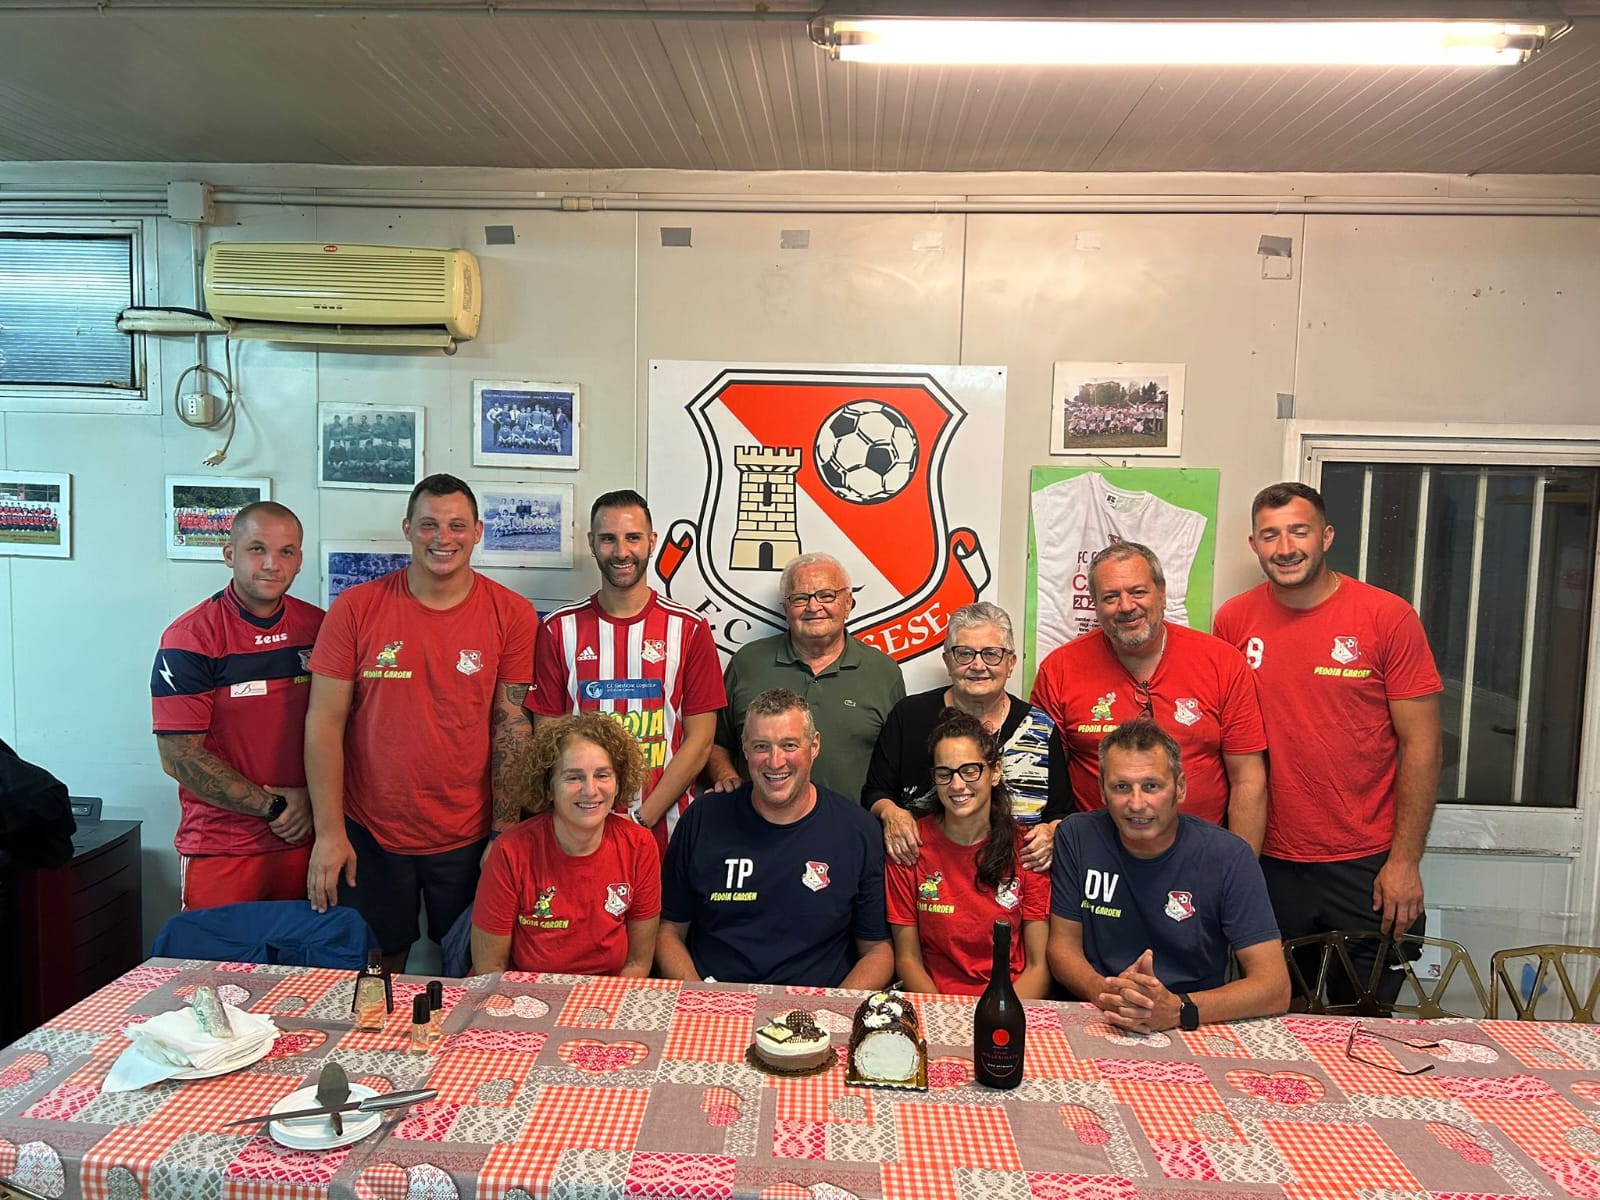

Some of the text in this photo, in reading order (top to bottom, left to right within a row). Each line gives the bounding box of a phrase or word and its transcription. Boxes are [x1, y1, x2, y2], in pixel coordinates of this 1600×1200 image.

[255, 632, 288, 645] Zeus
[724, 858, 754, 889] TP
[1084, 869, 1120, 903] DV
